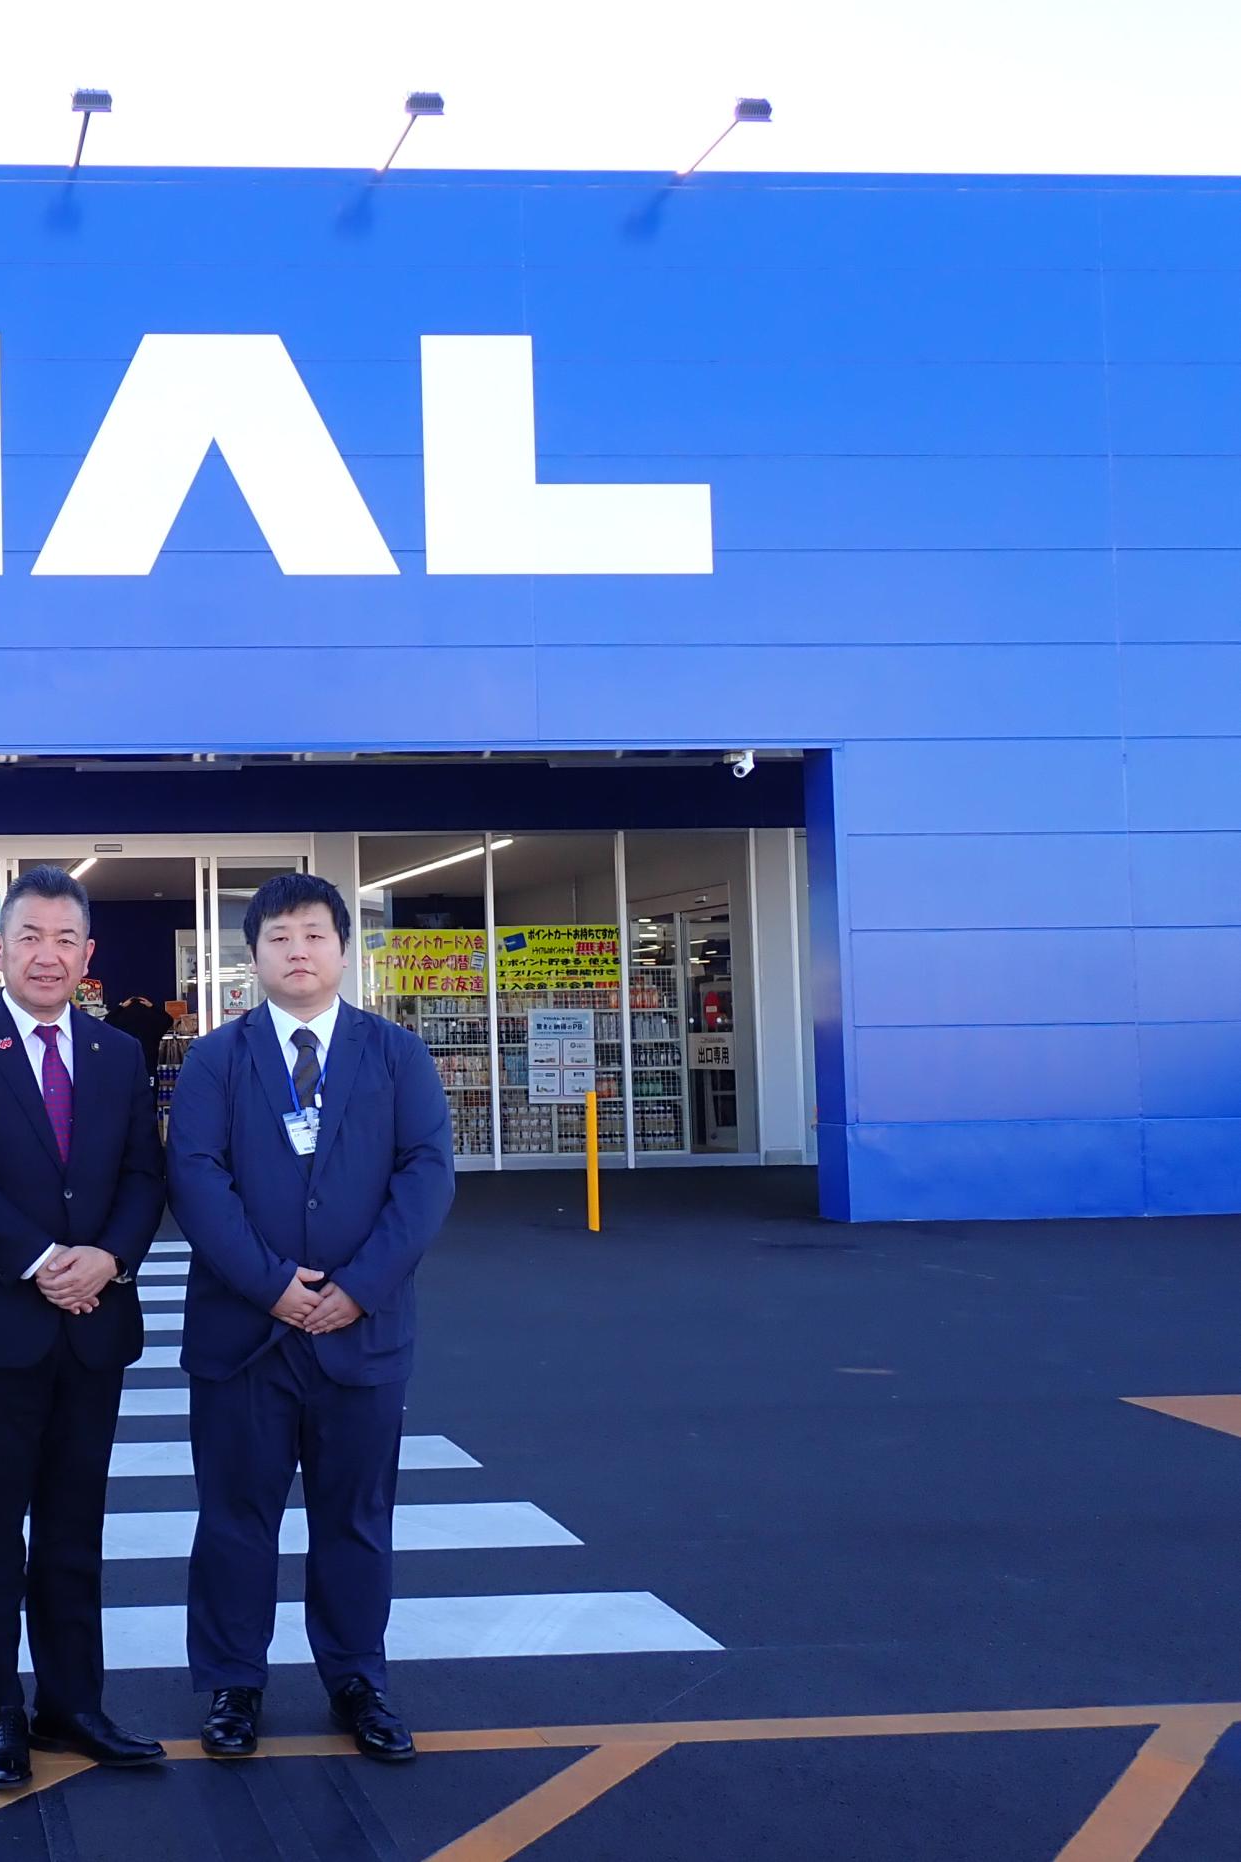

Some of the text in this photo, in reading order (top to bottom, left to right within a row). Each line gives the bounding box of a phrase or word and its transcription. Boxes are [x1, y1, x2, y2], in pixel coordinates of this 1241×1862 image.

[392, 935, 484, 949] ポイントカード入会
[575, 941, 619, 956] 無料
[698, 1046, 729, 1064] 出口専用
